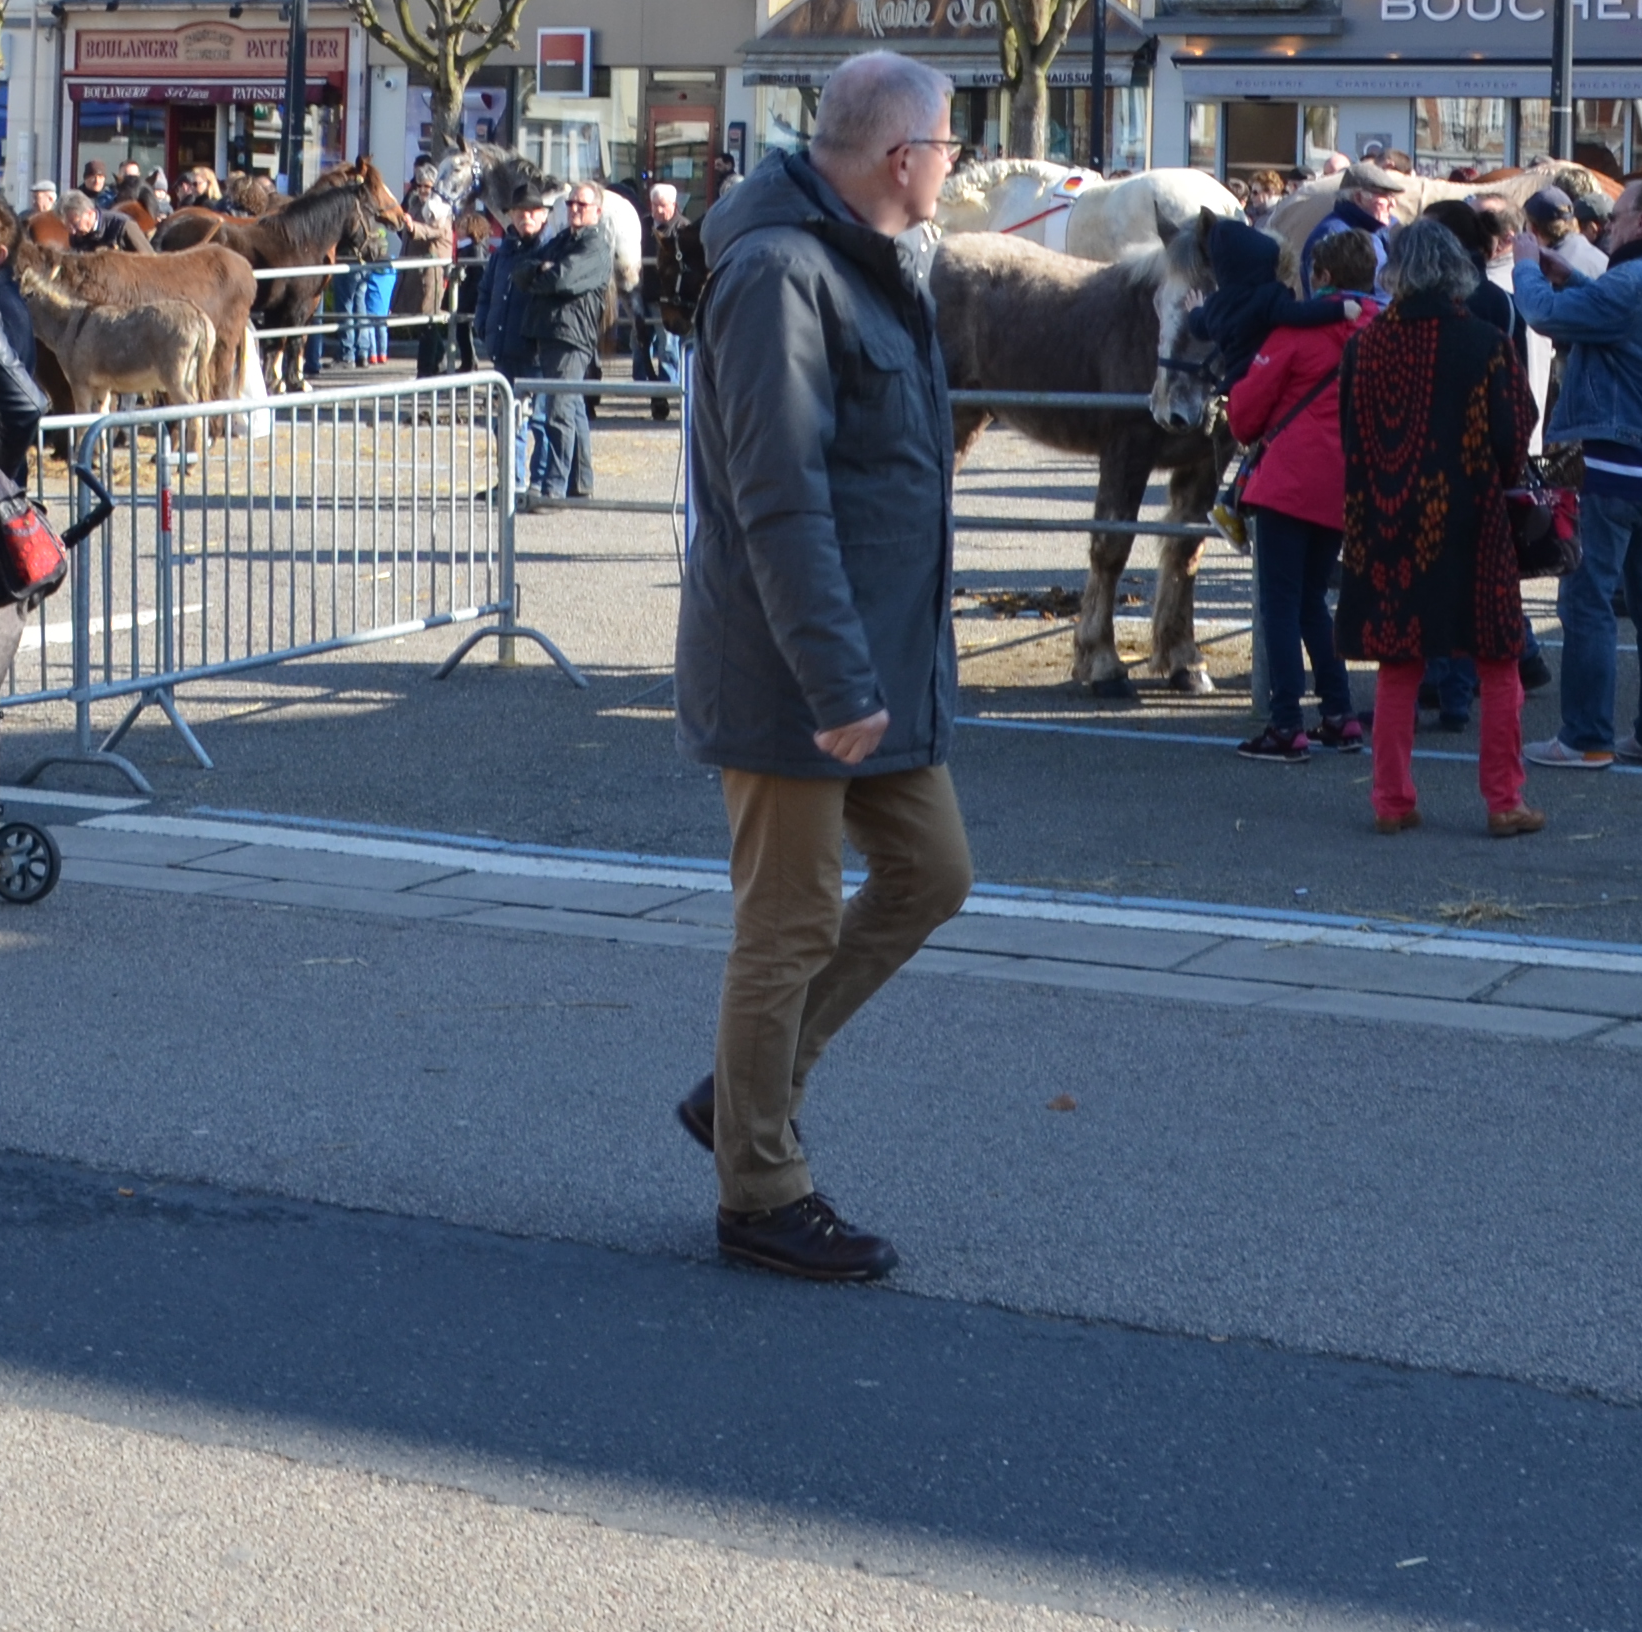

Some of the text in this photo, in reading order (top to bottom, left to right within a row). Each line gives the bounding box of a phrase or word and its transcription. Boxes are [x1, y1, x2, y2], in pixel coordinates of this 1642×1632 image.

[86, 39, 179, 59] BOULANGER
[247, 38, 339, 59] PATIIER
[759, 73, 812, 85] MERCERIE
[1235, 79, 1303, 88] BOUCHERIE
[1335, 79, 1423, 89] CHARCUTERIE
[83, 86, 152, 99] BOULANGERIE
[231, 87, 286, 100] PATISSER
